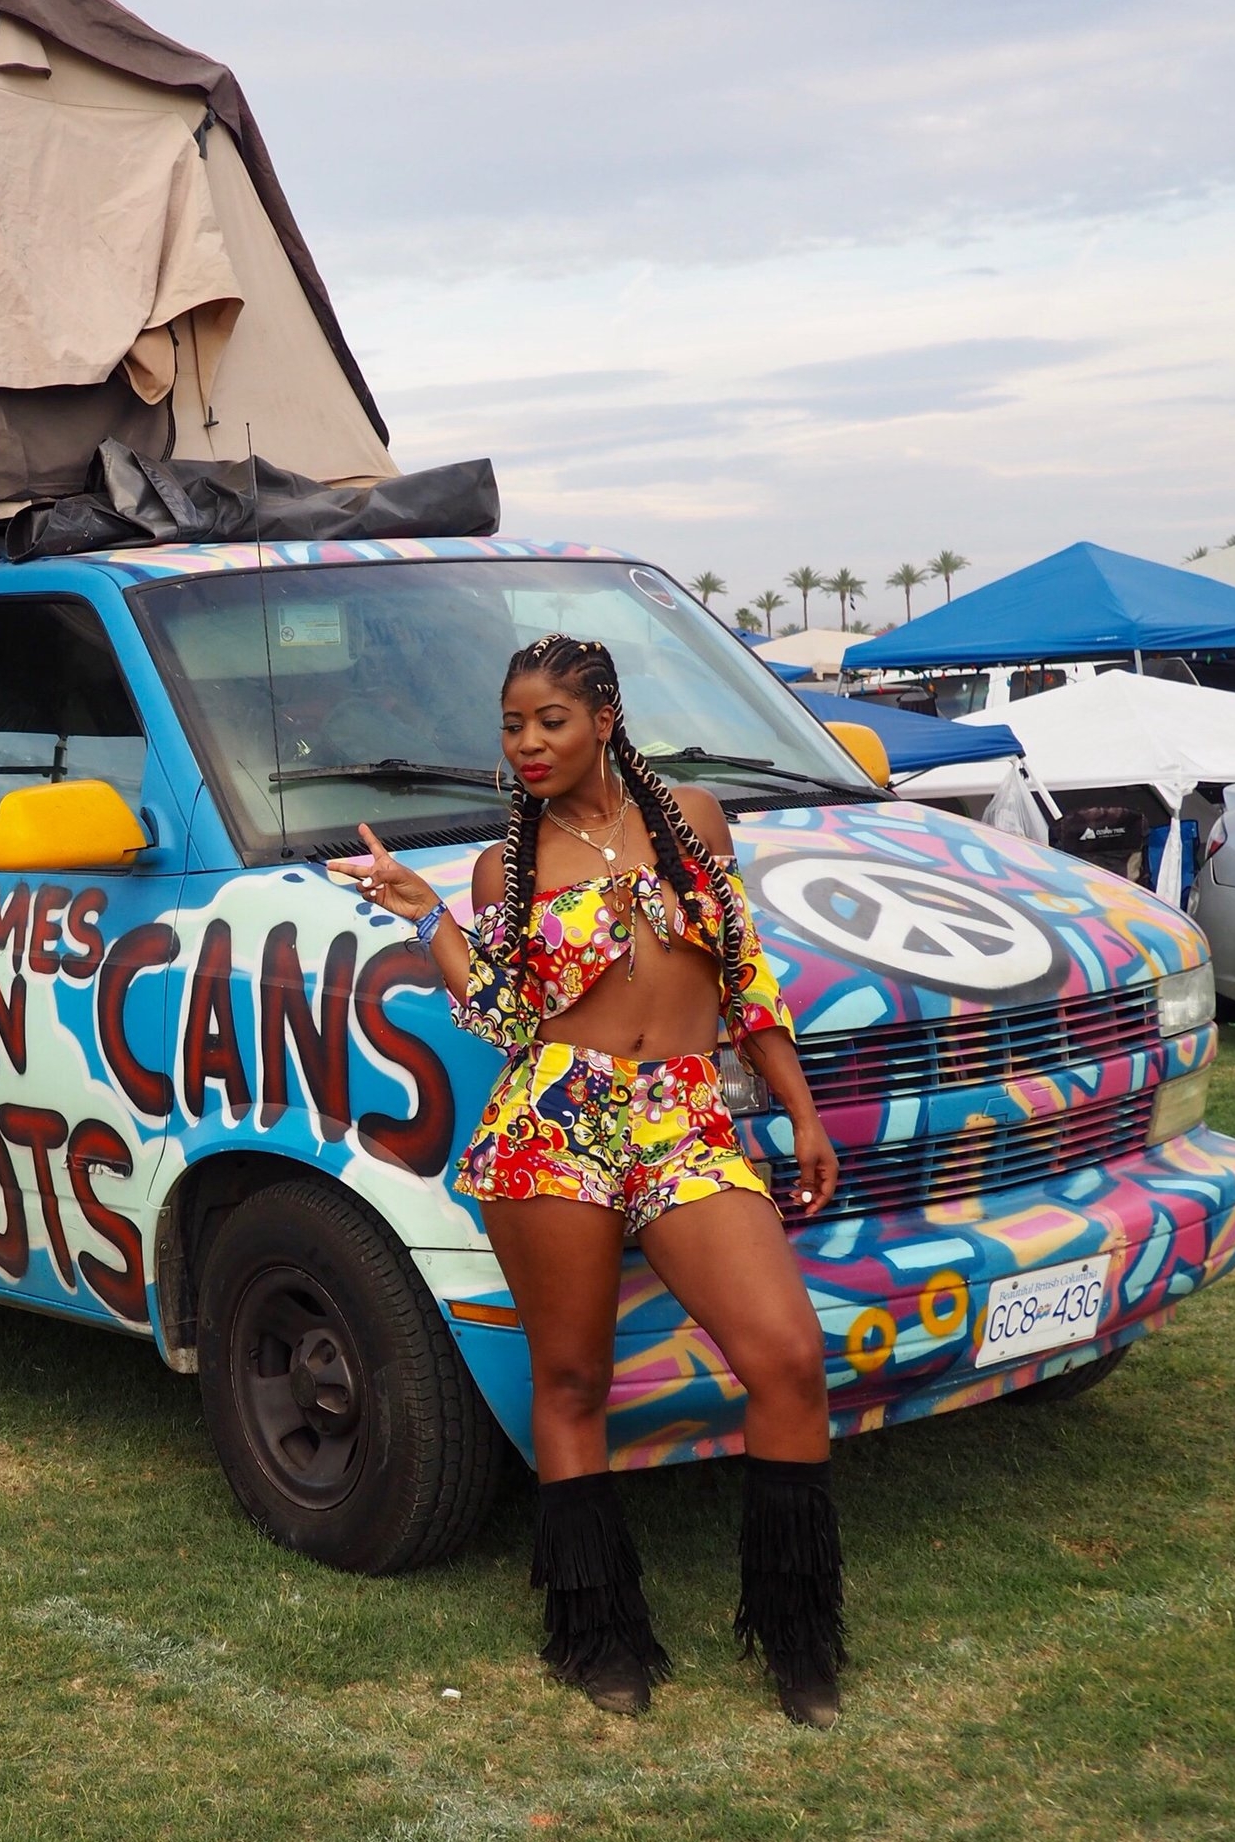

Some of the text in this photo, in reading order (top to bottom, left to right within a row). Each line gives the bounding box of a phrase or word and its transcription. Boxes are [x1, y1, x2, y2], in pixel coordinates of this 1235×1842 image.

[98, 918, 456, 1178] CANS
[989, 1281, 1102, 1342] GC8 43G
[999, 1269, 1098, 1302] Beautiful British Columbia
